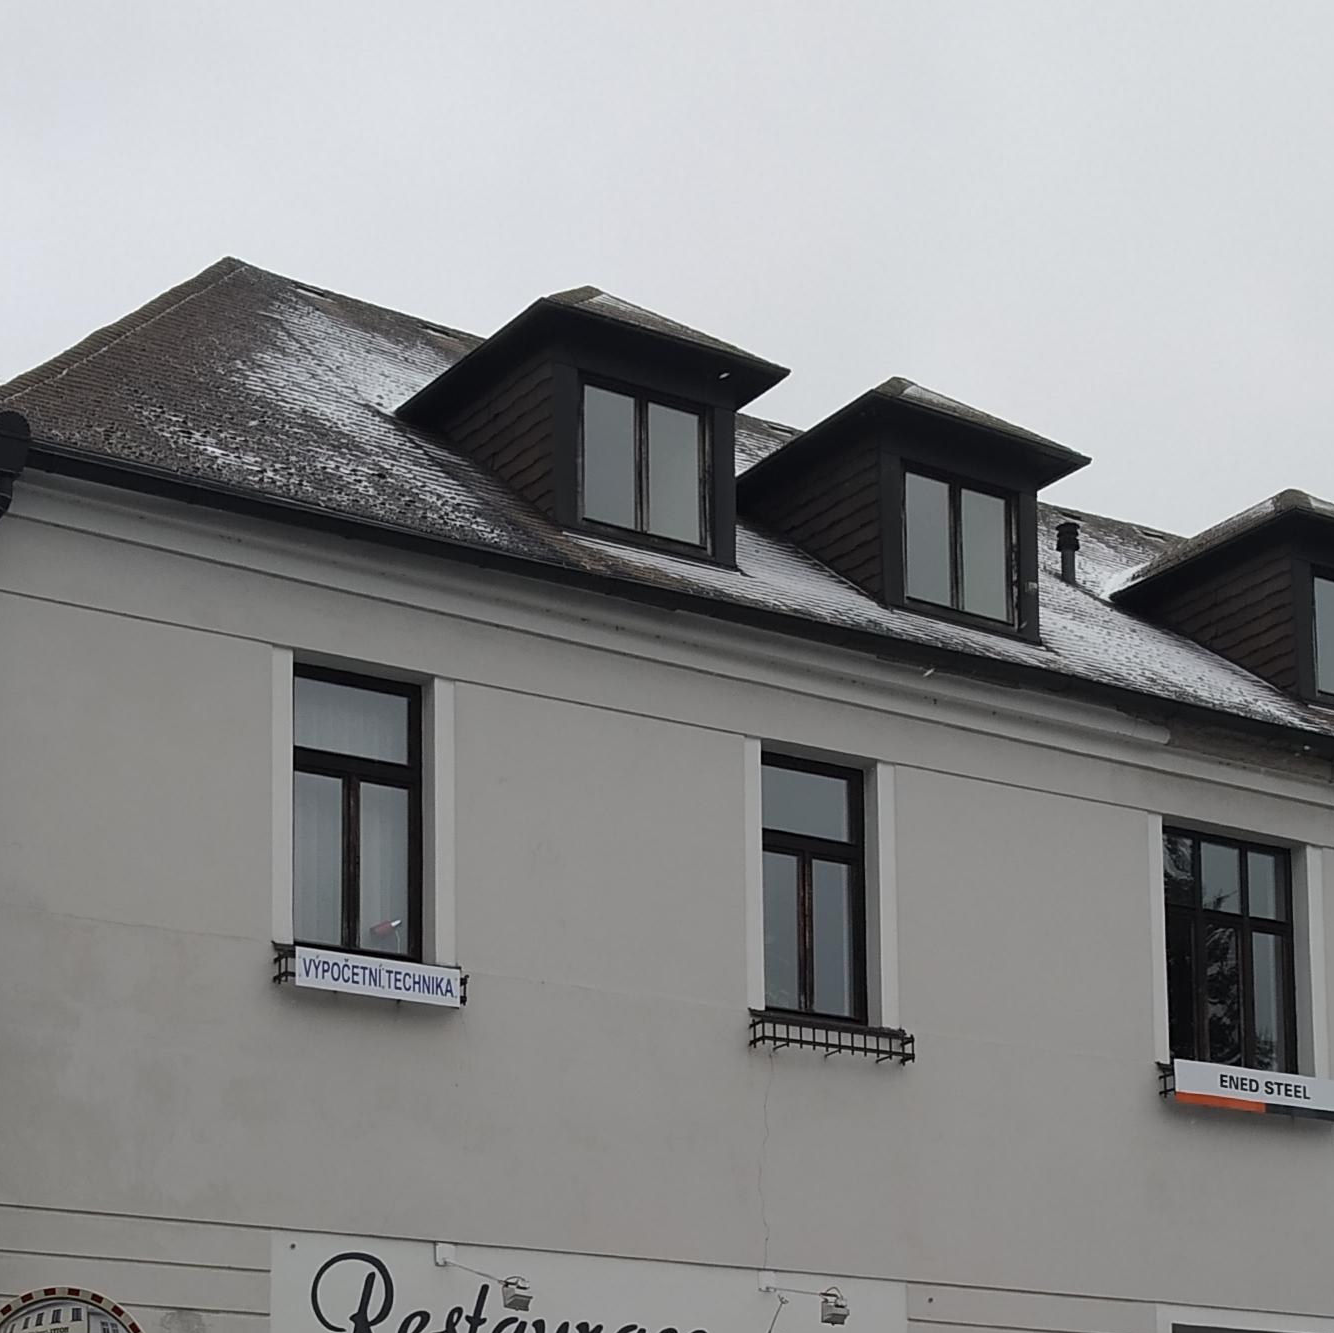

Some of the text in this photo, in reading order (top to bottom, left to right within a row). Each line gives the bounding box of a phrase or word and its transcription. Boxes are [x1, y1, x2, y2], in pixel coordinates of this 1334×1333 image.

[302, 954, 455, 998] VÝPOČETNÍ TECHNIKA
[1219, 1073, 1312, 1100] ENED STEEL
